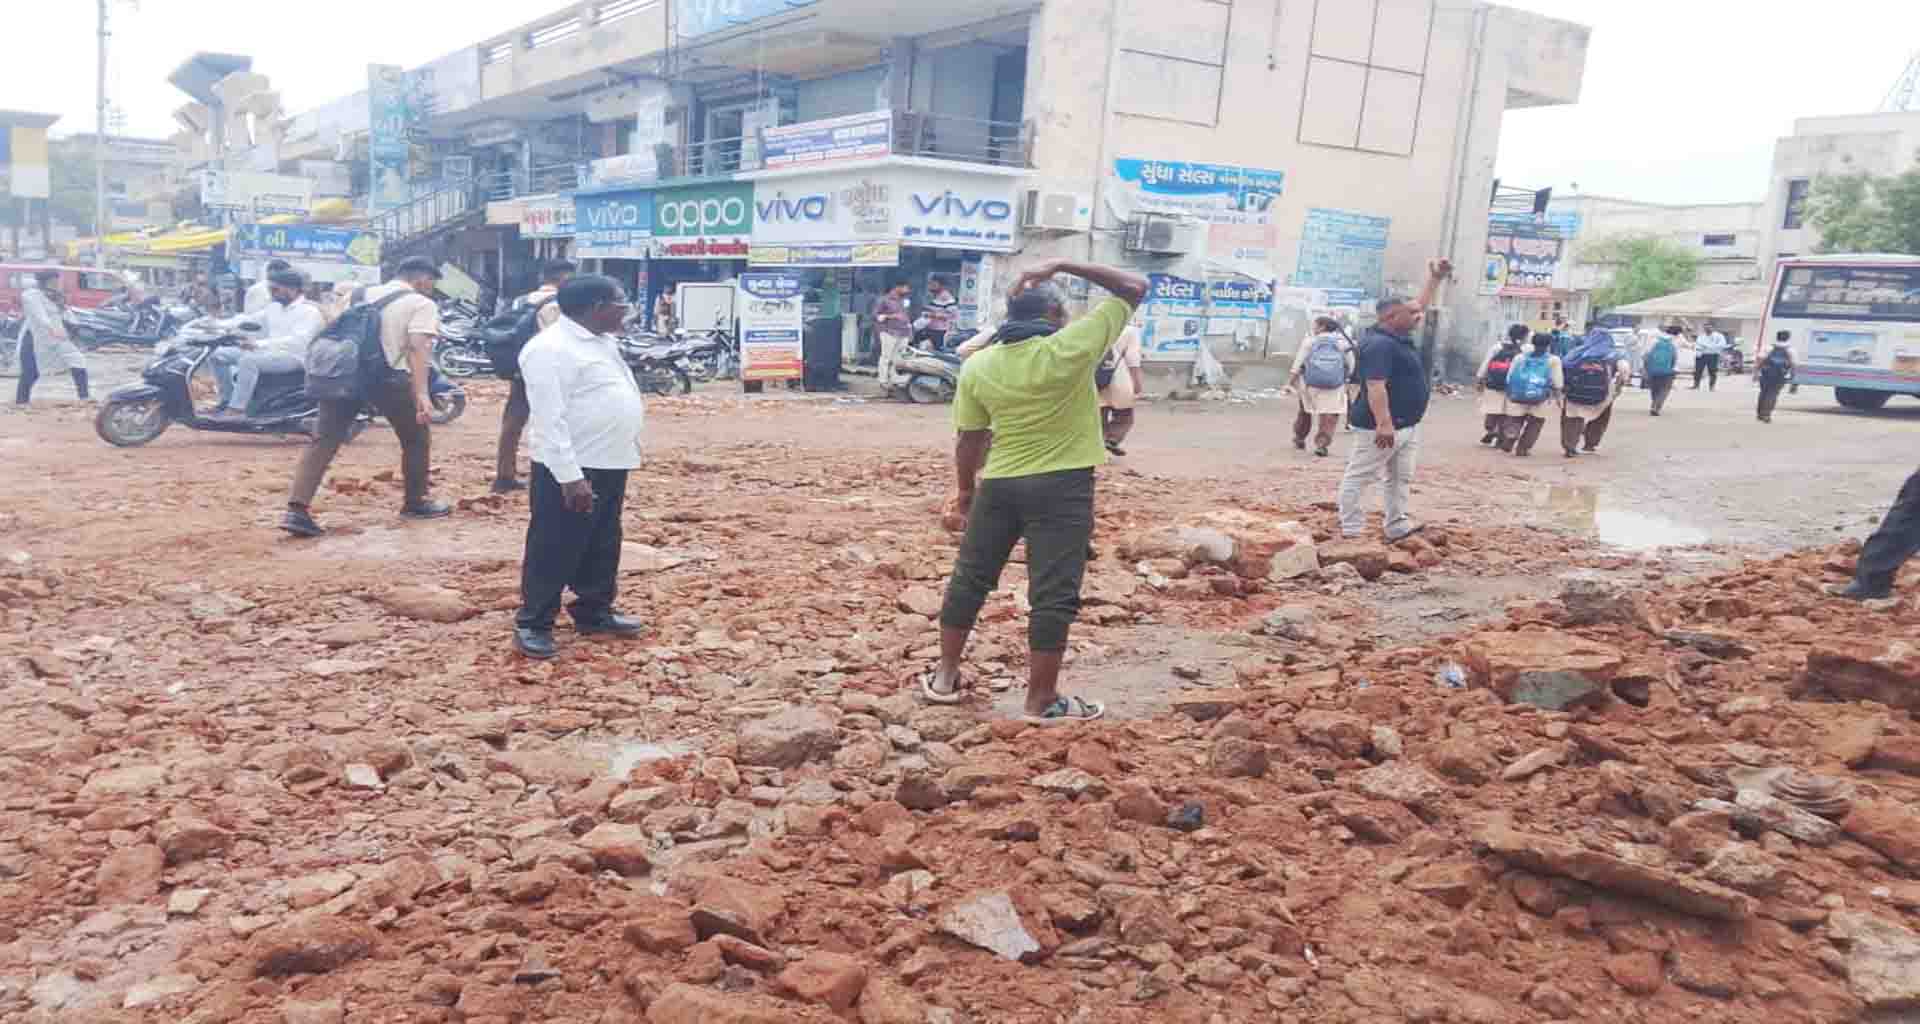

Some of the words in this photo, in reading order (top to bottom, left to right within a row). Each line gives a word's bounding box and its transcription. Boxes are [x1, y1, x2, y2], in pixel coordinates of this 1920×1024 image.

[586, 200, 638, 226] vivo
[659, 197, 745, 236] oppo
[756, 190, 828, 221] vivo
[912, 189, 1011, 220] vivo
